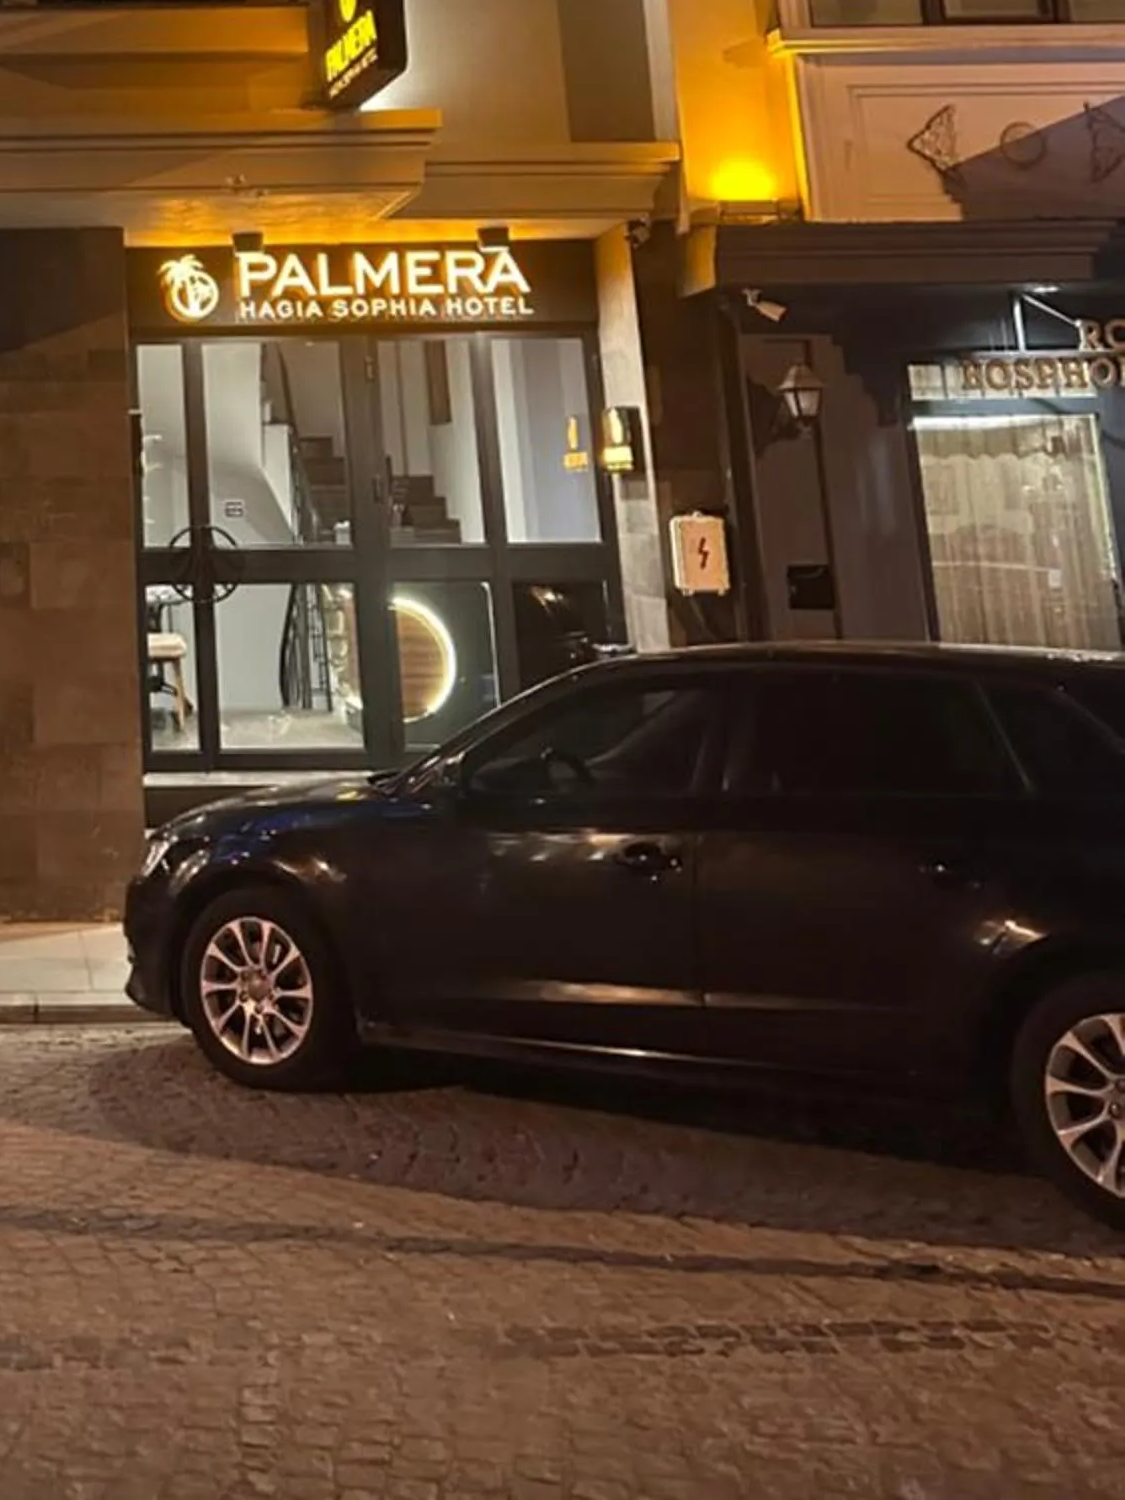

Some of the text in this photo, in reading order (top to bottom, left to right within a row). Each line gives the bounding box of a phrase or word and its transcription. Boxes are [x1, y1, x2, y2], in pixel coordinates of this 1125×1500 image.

[236, 248, 531, 297] PALMERA
[240, 295, 535, 318] HAGIA SOPHIA HOTEL
[961, 356, 1125, 390] BOSPHO
